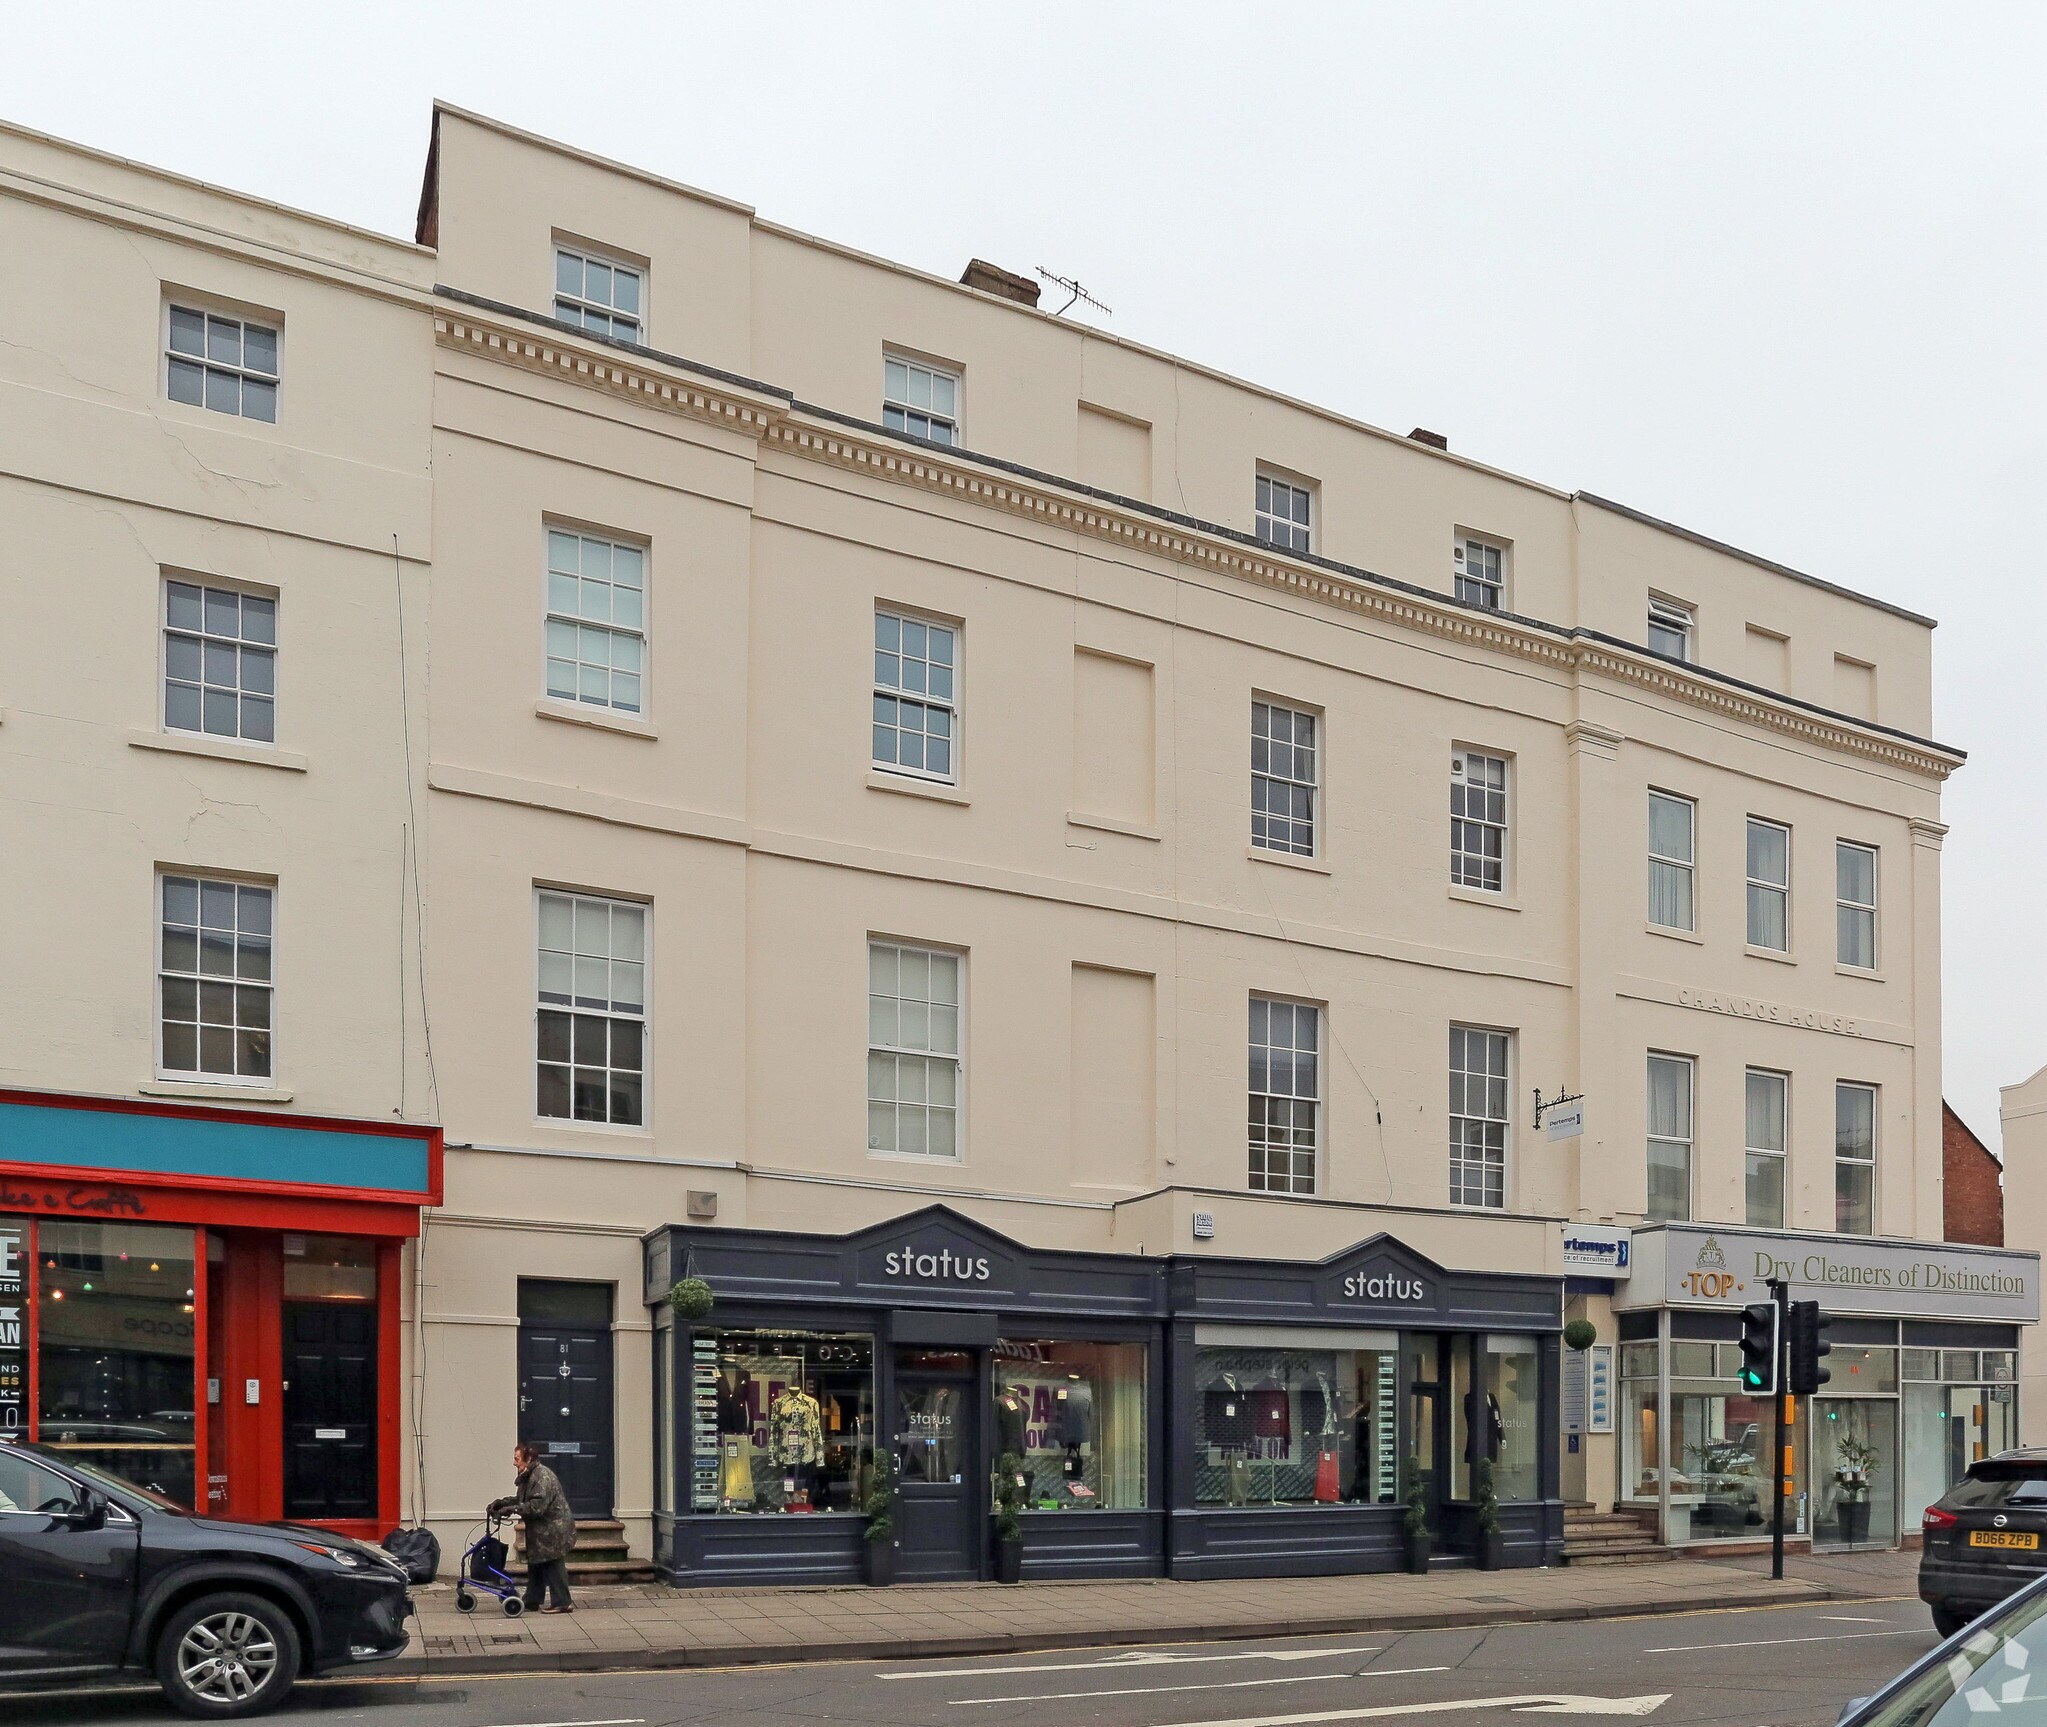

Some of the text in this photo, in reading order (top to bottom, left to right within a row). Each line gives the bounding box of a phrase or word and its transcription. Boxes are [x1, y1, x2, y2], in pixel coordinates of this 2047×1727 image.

[1678, 990, 1778, 1021] CHANDOS
[885, 1246, 990, 1280] status
[1754, 1252, 2025, 1294] Dry Cleaners of Distinction
[1343, 1271, 1424, 1300] status
[1687, 1271, 1735, 1298] TOP
[910, 1412, 952, 1425] status
[1497, 1417, 1528, 1428] status
[1975, 1532, 2033, 1547] BD66 ZPB
